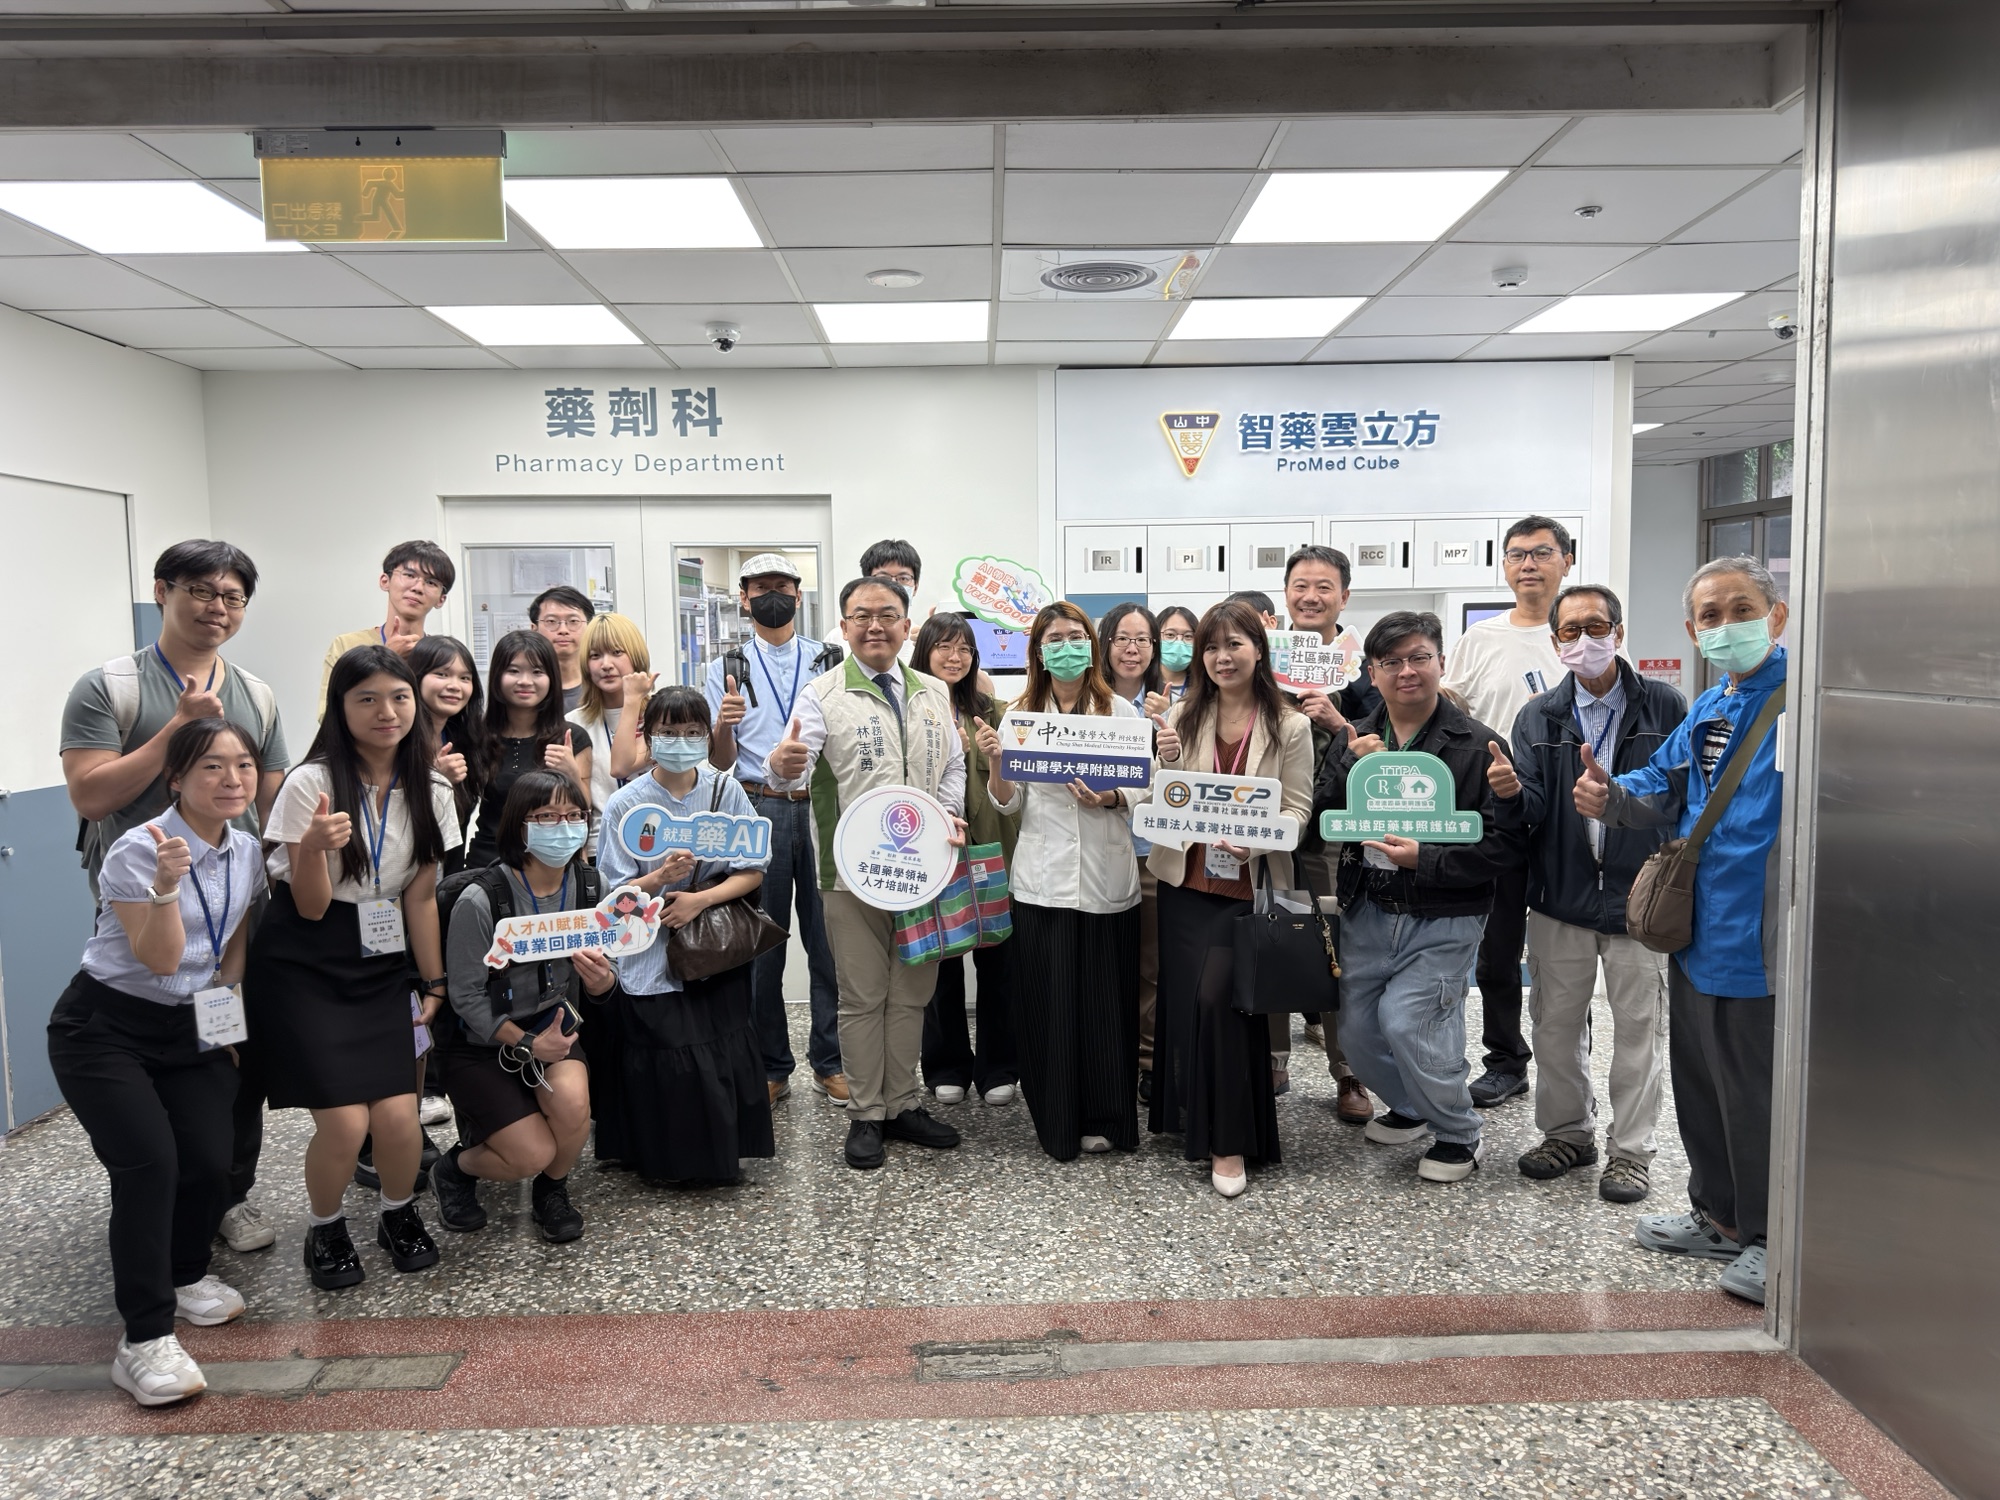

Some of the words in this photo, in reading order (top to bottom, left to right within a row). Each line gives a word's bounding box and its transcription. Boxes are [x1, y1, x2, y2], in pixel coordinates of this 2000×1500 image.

[544, 387, 723, 438] 藥劑科
[1238, 410, 1440, 450] 智藥雲立方
[496, 454, 624, 476] Pharmacy
[635, 453, 785, 475] Department
[1277, 457, 1346, 471] ProMed
[1353, 456, 1400, 470] Cube
[1100, 555, 1112, 565] IR
[1183, 554, 1194, 564] PI
[1265, 552, 1278, 563] NI
[1360, 549, 1384, 560] RCC
[1444, 548, 1468, 559] MP7
[971, 571, 1001, 595] 藥局
[1292, 635, 1318, 648] 數位
[1290, 650, 1344, 665] 社區藥局
[1288, 665, 1344, 686] 再進化
[869, 714, 885, 758] 常務理事
[856, 725, 874, 772] 林志勇
[1010, 758, 1144, 780] 中山醫學大學附設醫院
[1380, 766, 1421, 776] TTPA
[1194, 782, 1271, 804] TSCP
[1144, 816, 1285, 840] 社團法人臺灣社區藥學會
[1330, 819, 1471, 833] 臺灣遠距藥事照護協會
[858, 861, 928, 884] 全國藥學領袖
[861, 876, 920, 896] 人才培訓社
[504, 915, 588, 937] 人才AI賦能
[513, 930, 617, 956] 專業回歸藥師
